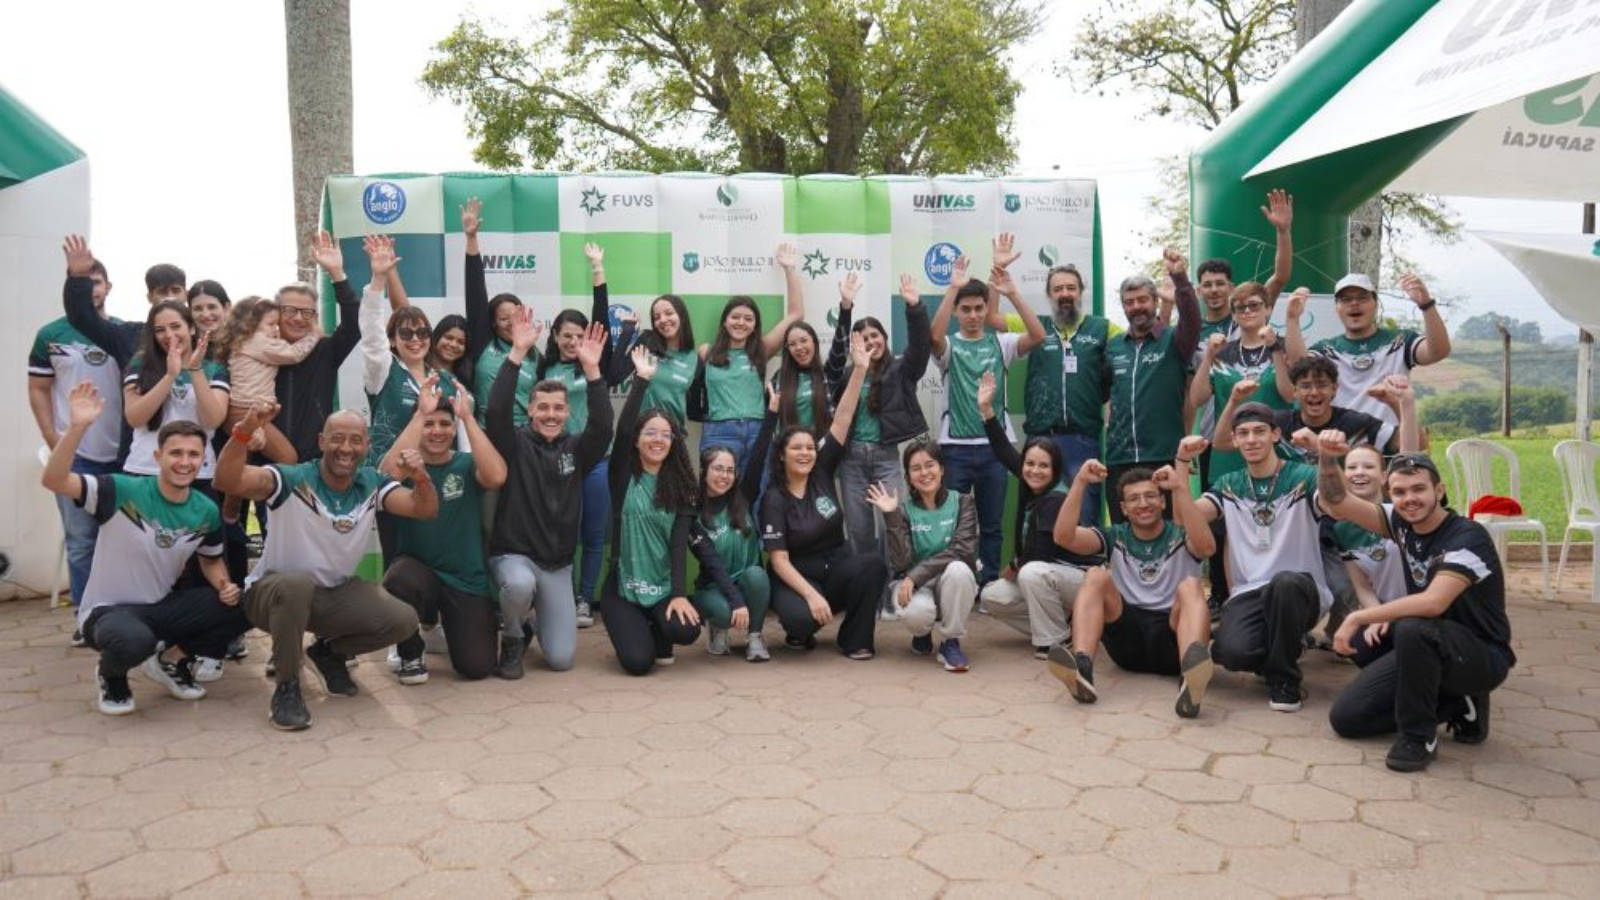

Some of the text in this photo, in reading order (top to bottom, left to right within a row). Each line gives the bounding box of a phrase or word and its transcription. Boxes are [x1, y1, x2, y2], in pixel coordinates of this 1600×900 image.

[370, 199, 397, 213] anglo
[612, 194, 654, 207] FUVS
[913, 195, 975, 208] UNIVAS
[482, 255, 536, 269] NIVAS
[836, 258, 872, 271] FUVS
[930, 261, 951, 276] angl
